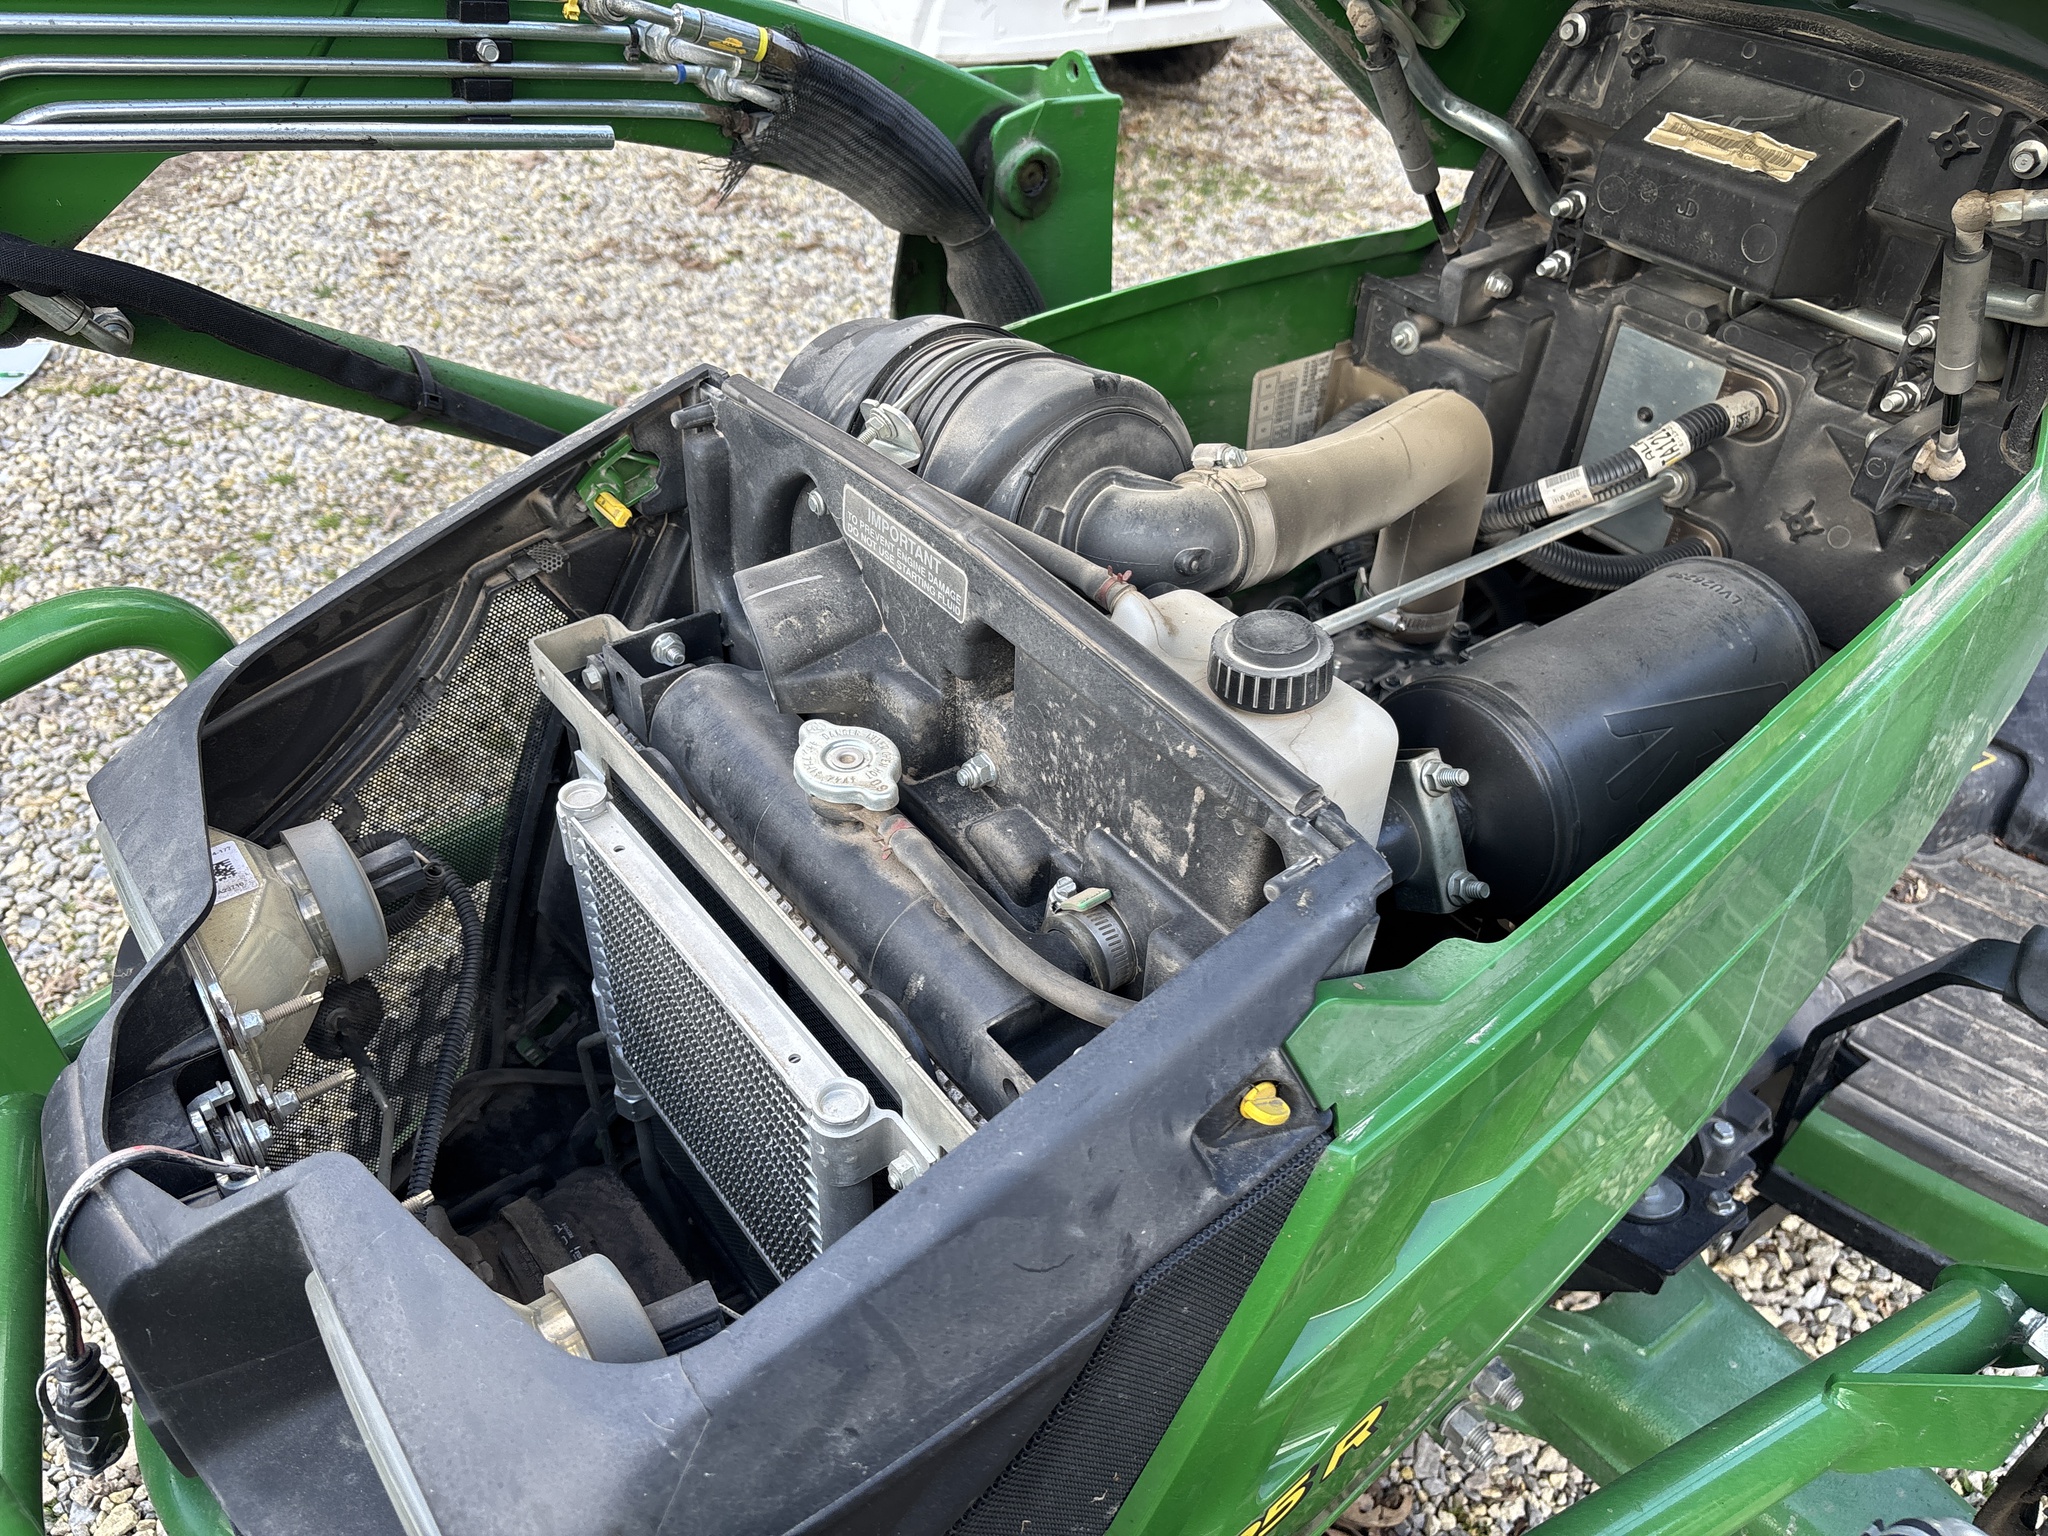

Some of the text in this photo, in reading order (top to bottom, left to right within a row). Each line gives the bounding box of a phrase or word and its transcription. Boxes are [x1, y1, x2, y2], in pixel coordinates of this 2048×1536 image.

[1675, 198, 1700, 219] JD
[847, 511, 962, 606] TO PREVENT ENGINE DAMAGE
[847, 522, 961, 616] DO NOT USE STARTING FLUID
[867, 507, 942, 574] IMPORTANT
[821, 728, 862, 741] DANGER
[866, 766, 884, 780] HOT
[1320, 1400, 1390, 1483] R
